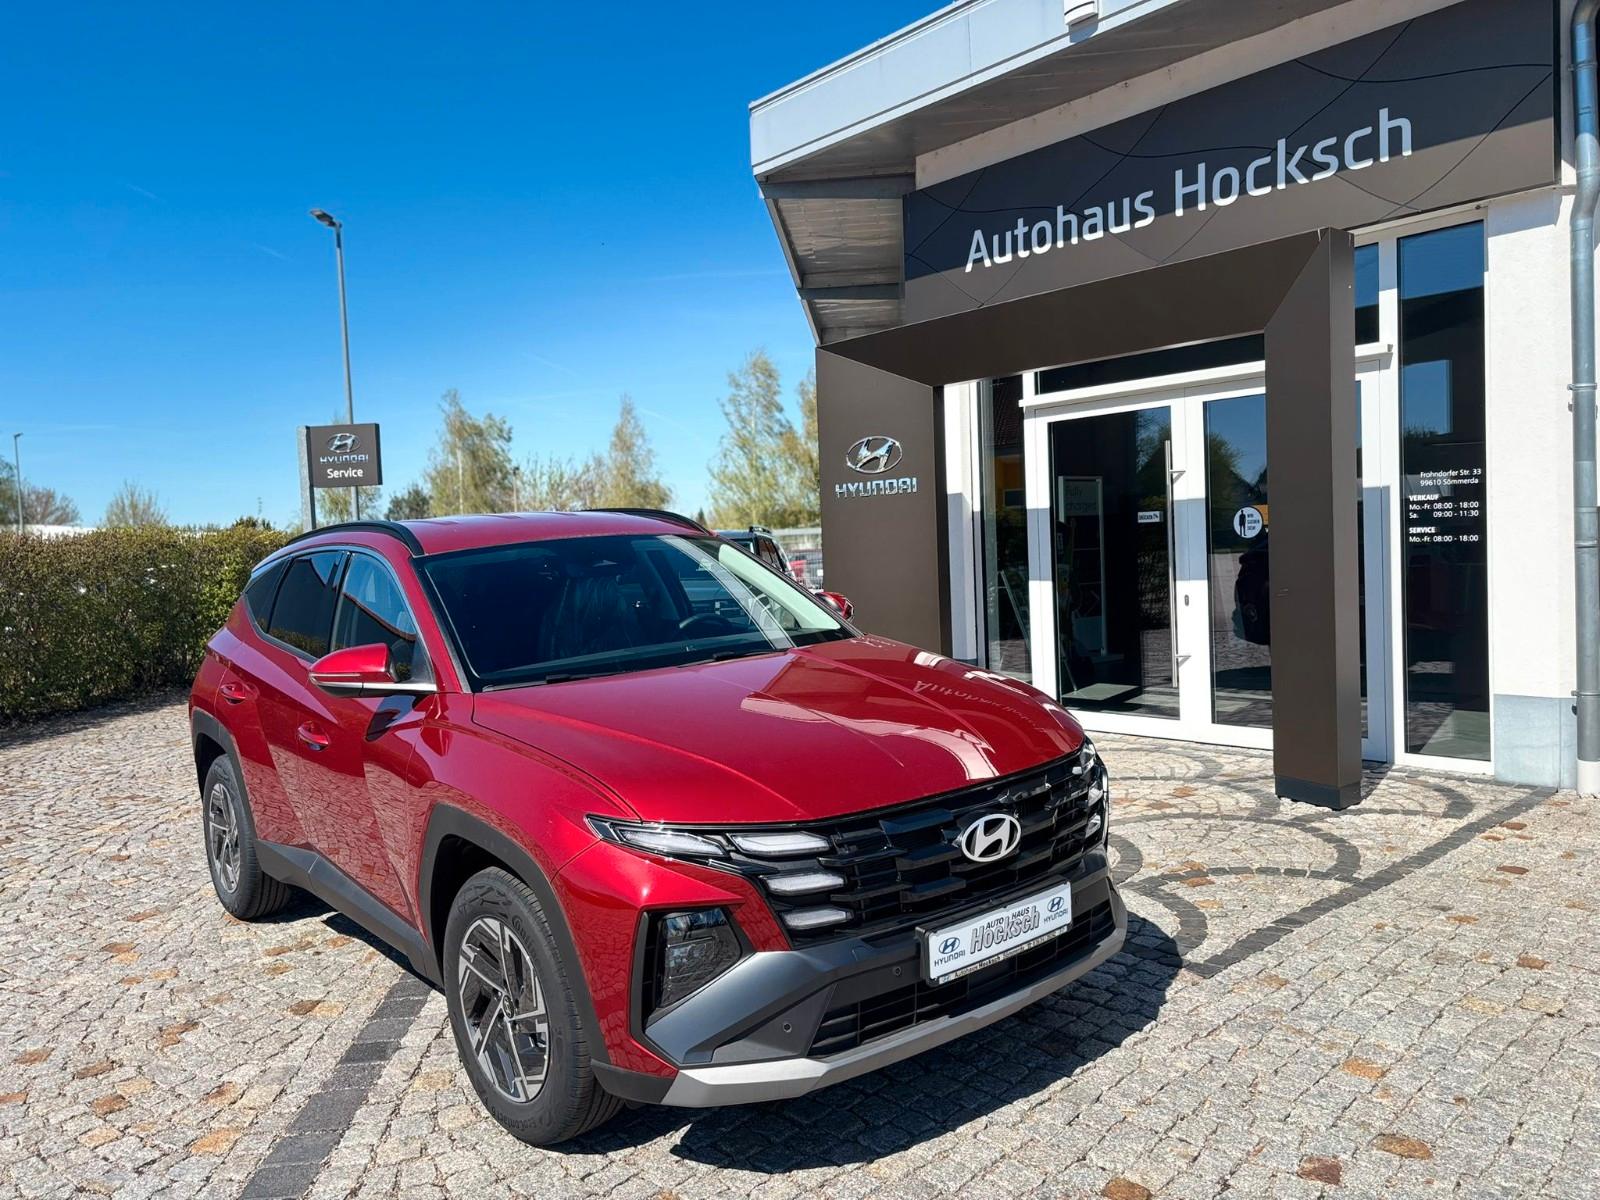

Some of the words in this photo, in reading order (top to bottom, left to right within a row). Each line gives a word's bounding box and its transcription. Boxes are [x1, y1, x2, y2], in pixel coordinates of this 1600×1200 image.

[964, 189, 1156, 273] Autohaus
[1174, 107, 1413, 217] Hocksch
[319, 454, 369, 464] HYUNDAI
[326, 467, 364, 479] Service
[1420, 470, 1459, 478] Frohndorfer
[835, 477, 917, 498] HYUNDAI
[1420, 479, 1442, 487] 99610
[1442, 477, 1478, 485] Sömmerda
[1409, 526, 1436, 534] SERVICE
[986, 917, 1005, 930] AUTO
[1012, 906, 1030, 919] HAUS
[1043, 908, 1069, 925] HYUNDAI
[970, 905, 1041, 955] Hocksch
[934, 950, 966, 967] HYUNDAI
